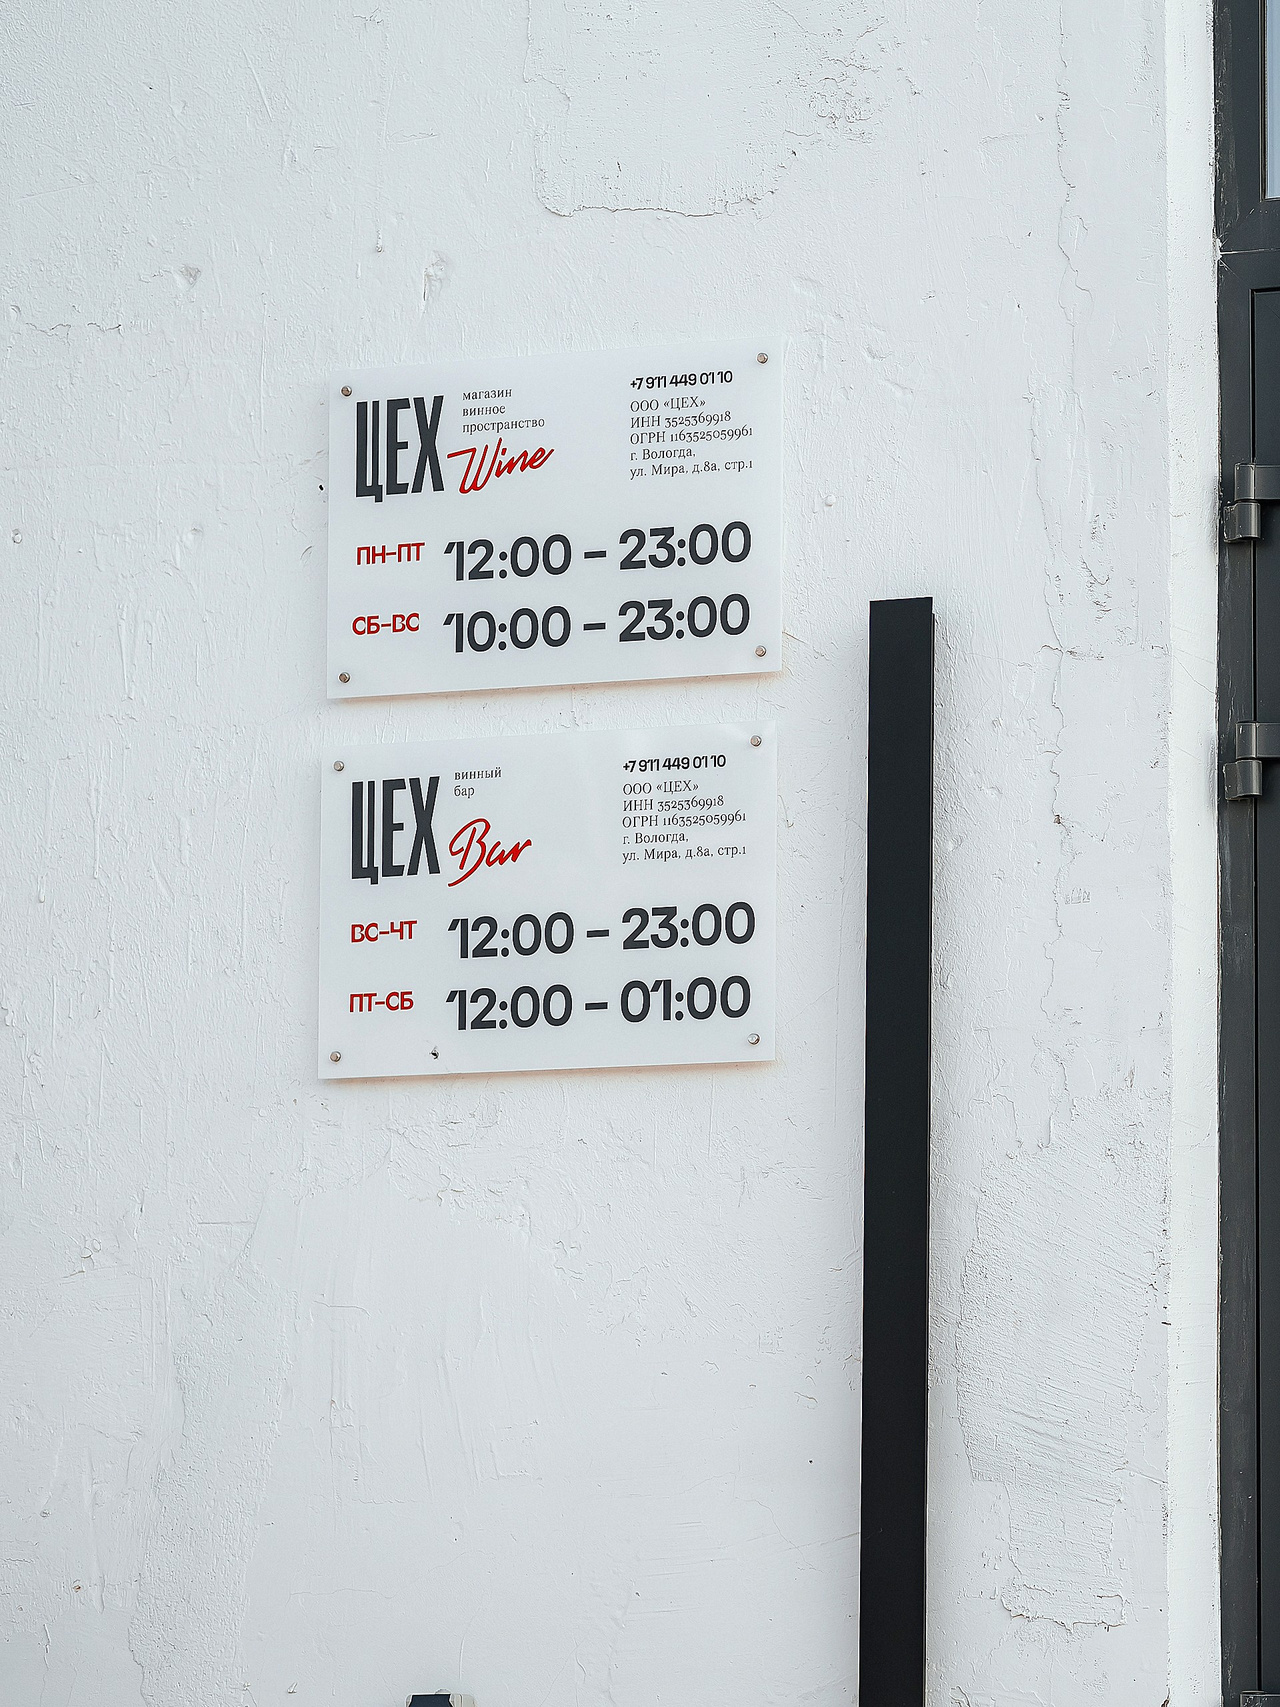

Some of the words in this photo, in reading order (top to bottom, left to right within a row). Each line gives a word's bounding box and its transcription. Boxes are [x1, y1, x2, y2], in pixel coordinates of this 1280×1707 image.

[630, 377, 644, 390] +7
[645, 376, 667, 389] 911
[669, 373, 697, 387] 449
[700, 371, 715, 385] 01
[717, 370, 733, 383] 10
[462, 389, 512, 400] магазин
[462, 405, 505, 416] винное
[630, 399, 659, 412] ООО
[663, 396, 706, 411] «ЦЕХ»
[462, 418, 545, 435] пространство
[630, 415, 661, 428] ИНН
[664, 411, 731, 428] 3525369918
[630, 431, 666, 445] ОГРН
[670, 424, 753, 443] 1163525059961
[355, 395, 445, 503] ЦЕХ
[630, 452, 638, 461] г.
[642, 448, 696, 460] Вологда,
[447, 437, 554, 494] Wine
[630, 468, 647, 480] ул.
[651, 464, 689, 477] Мира,
[692, 461, 720, 474] д.8а,
[724, 460, 753, 472] стр.1
[356, 542, 425, 566] ПН-ПТ
[443, 534, 572, 582] 12:00
[618, 521, 752, 571] 23:00
[352, 612, 420, 636] СБ-ВС
[442, 605, 571, 654] 10:00
[618, 593, 750, 643] 23:00
[622, 760, 636, 772] +7
[638, 759, 660, 772] 911
[662, 757, 690, 770] 449
[692, 755, 708, 769] 01
[710, 754, 727, 768] 10
[454, 766, 502, 780] винный
[454, 785, 475, 798] бар
[623, 782, 652, 795] ООО
[656, 780, 699, 794] «ЦЕХ»
[623, 799, 654, 812] ИНН
[657, 795, 724, 812] 3525369918
[622, 815, 659, 828] ОГРН
[663, 809, 747, 827] 1163525059961
[351, 776, 441, 886] ЦЕХ
[623, 836, 630, 844] г.
[635, 832, 689, 844] Вологда,
[448, 818, 532, 887] Bar
[622, 852, 639, 864] ул.
[644, 848, 681, 862] Мира,
[685, 846, 714, 859] д.8а,
[717, 846, 747, 858] стр.1
[350, 920, 418, 943] ВС-ЧТ
[447, 911, 575, 960] 12:00
[621, 901, 756, 951] 23:00
[349, 991, 415, 1013] ПТ-СБ
[446, 984, 573, 1031] 12:00
[620, 975, 751, 1024] 01:00
